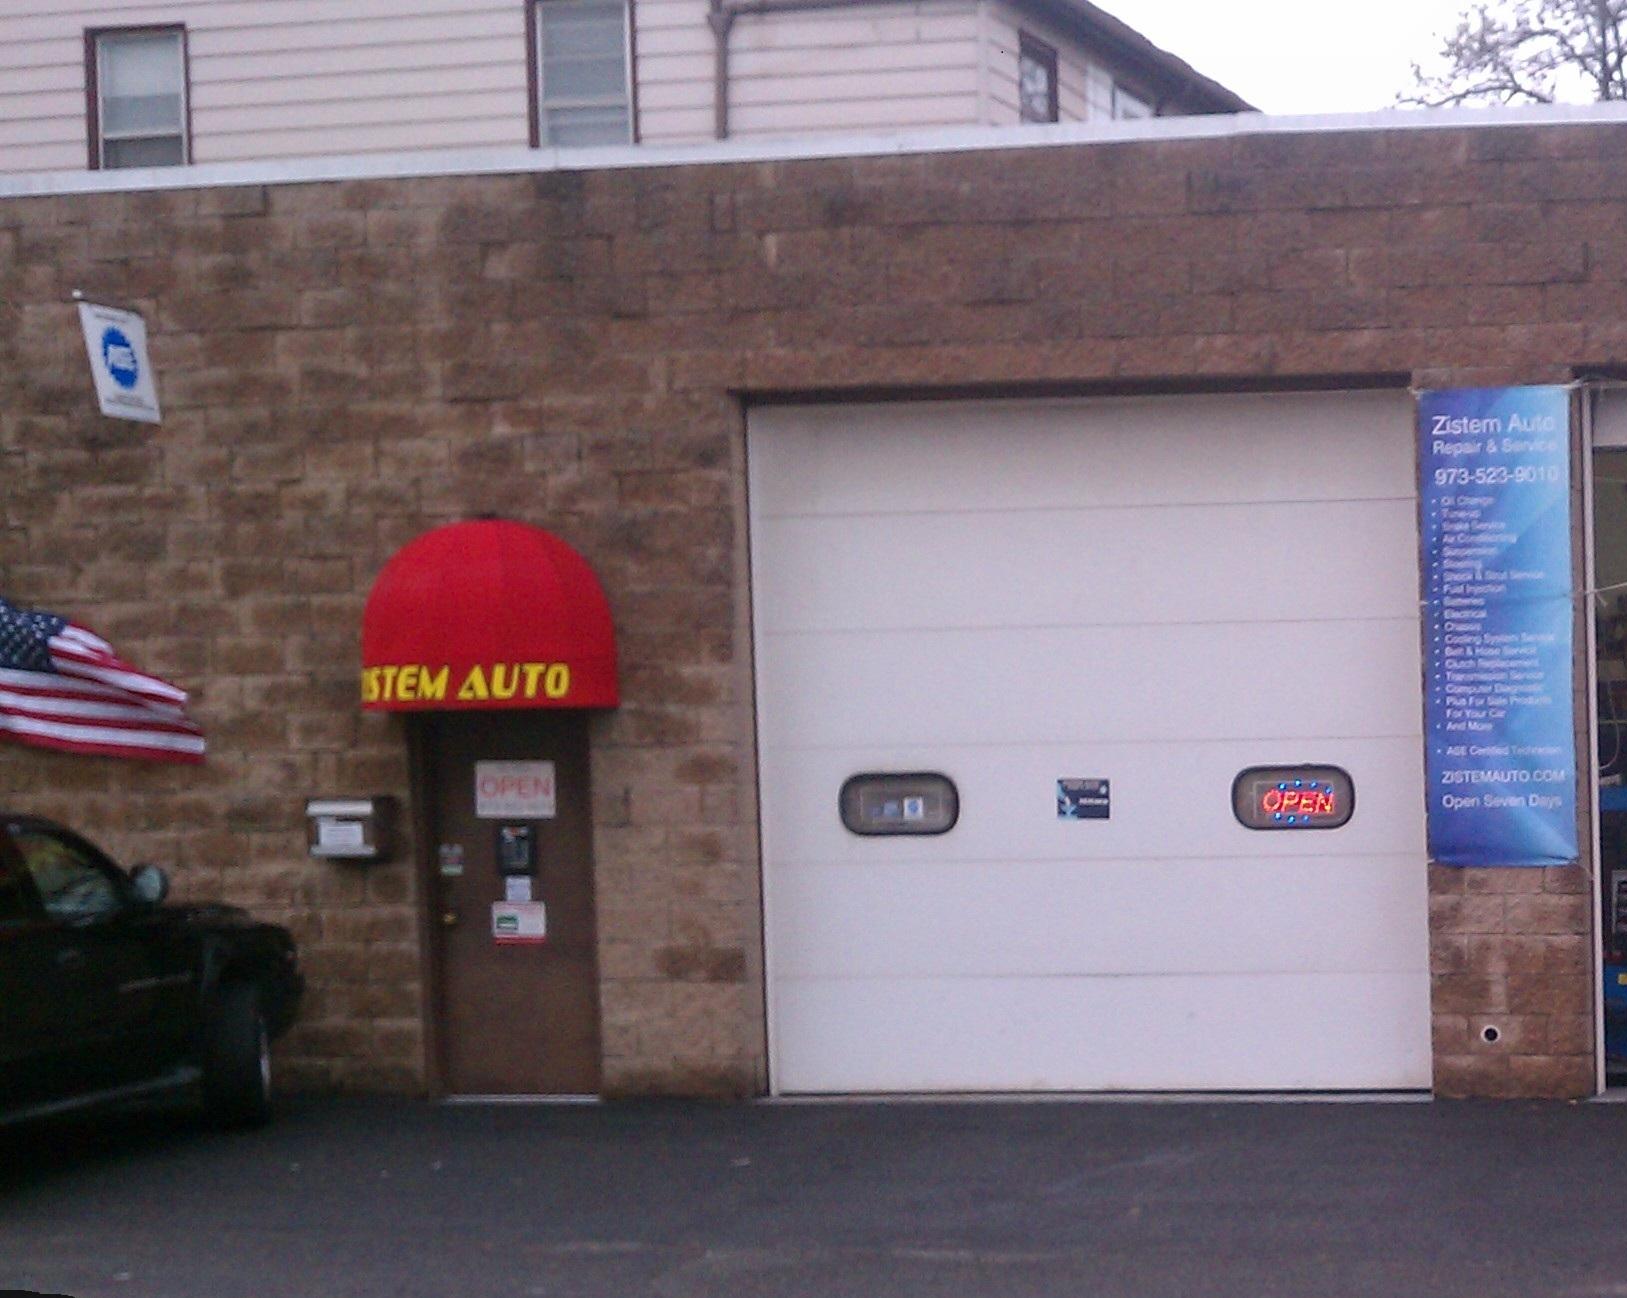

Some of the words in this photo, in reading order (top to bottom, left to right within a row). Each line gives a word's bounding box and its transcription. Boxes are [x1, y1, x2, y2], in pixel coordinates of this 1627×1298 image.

[1432, 415, 1501, 435] Zistem
[1508, 413, 1554, 433] Auto
[1433, 440, 1481, 457] Repair
[1486, 439, 1497, 453] &
[1502, 437, 1557, 453] Service
[1435, 466, 1558, 486] 973-523-9010
[458, 663, 571, 700] AUTO
[480, 775, 550, 800] OPEN
[1263, 789, 1334, 814] OPEN
[1443, 794, 1479, 809] Open
[1484, 793, 1527, 807] Seven
[1529, 793, 1562, 808] Days
